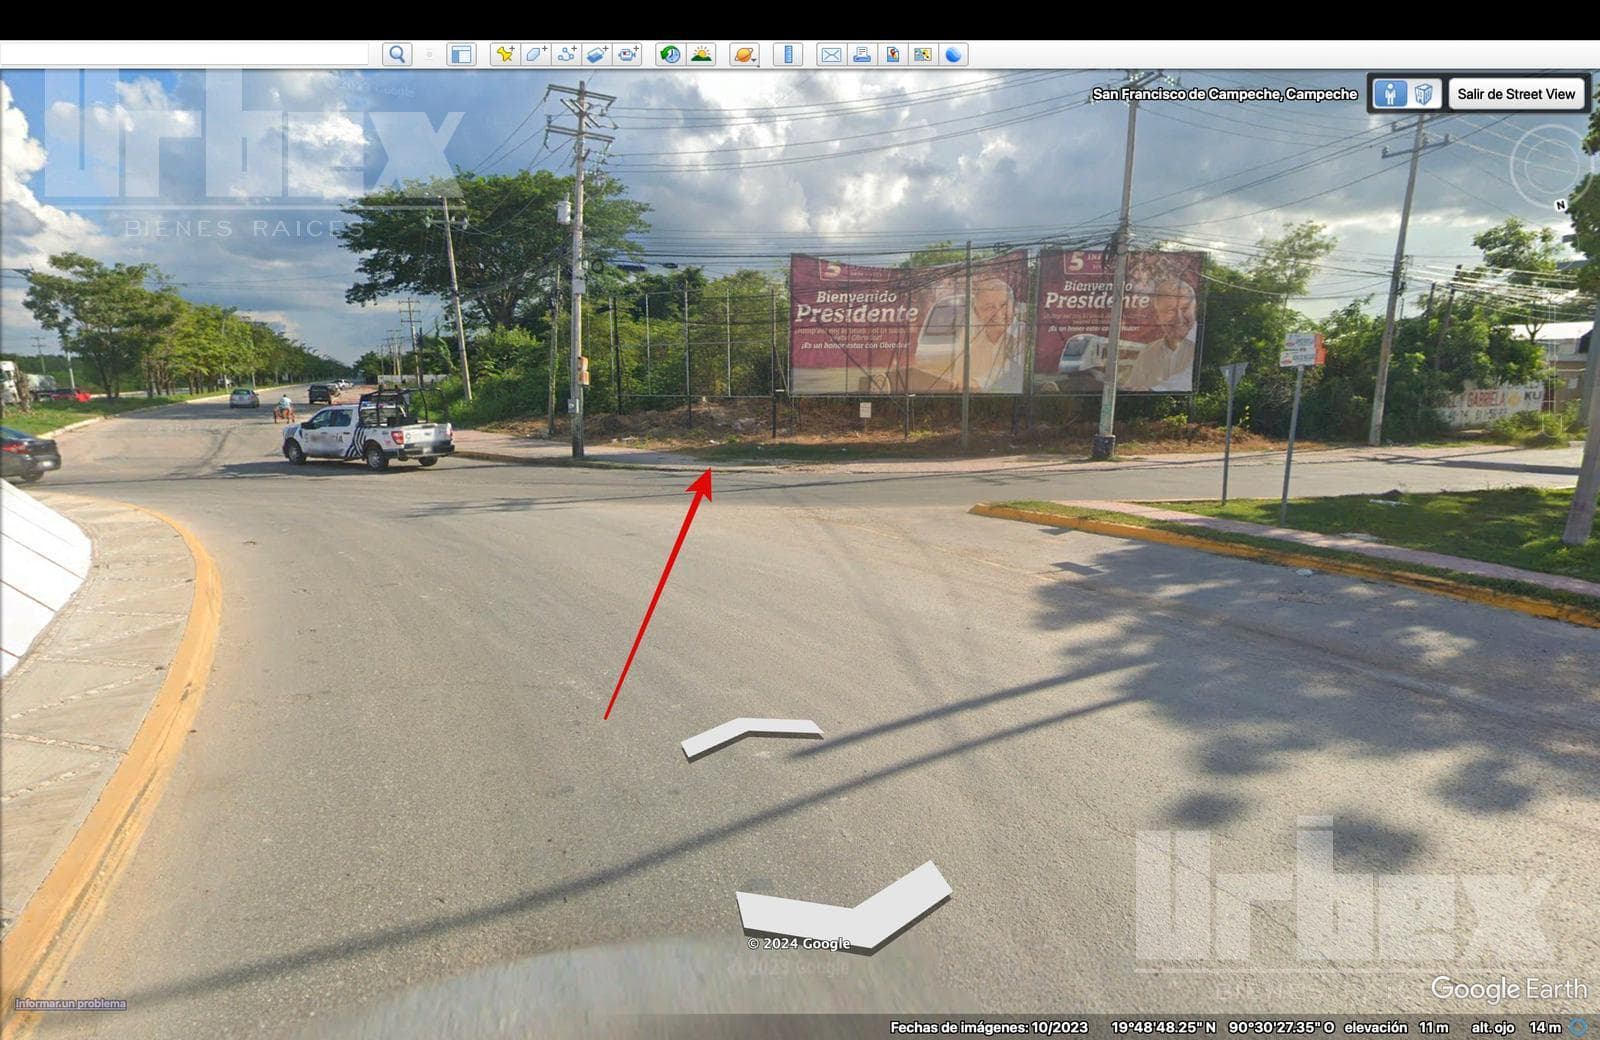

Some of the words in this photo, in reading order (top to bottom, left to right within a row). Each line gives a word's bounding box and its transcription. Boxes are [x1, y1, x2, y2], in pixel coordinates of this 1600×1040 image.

[1068, 251, 1084, 271] 5
[816, 291, 897, 303] Bienvenido
[795, 304, 919, 323] Presidente
[823, 341, 845, 349] honor
